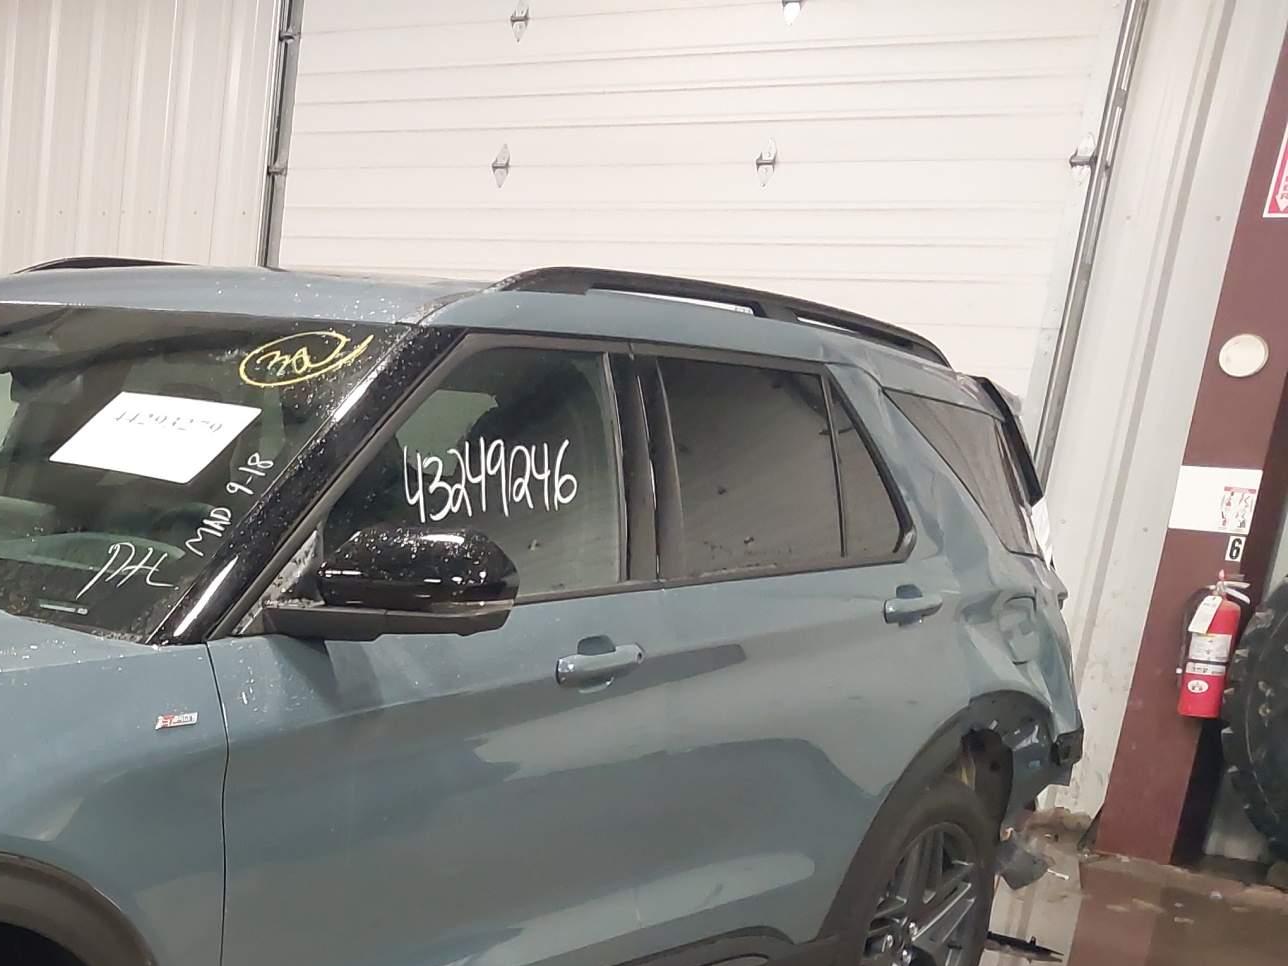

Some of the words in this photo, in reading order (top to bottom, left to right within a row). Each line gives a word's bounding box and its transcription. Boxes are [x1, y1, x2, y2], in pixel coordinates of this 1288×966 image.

[225, 452, 274, 495] 9-18
[403, 436, 578, 524] 43249246
[1228, 537, 1243, 560] 6
